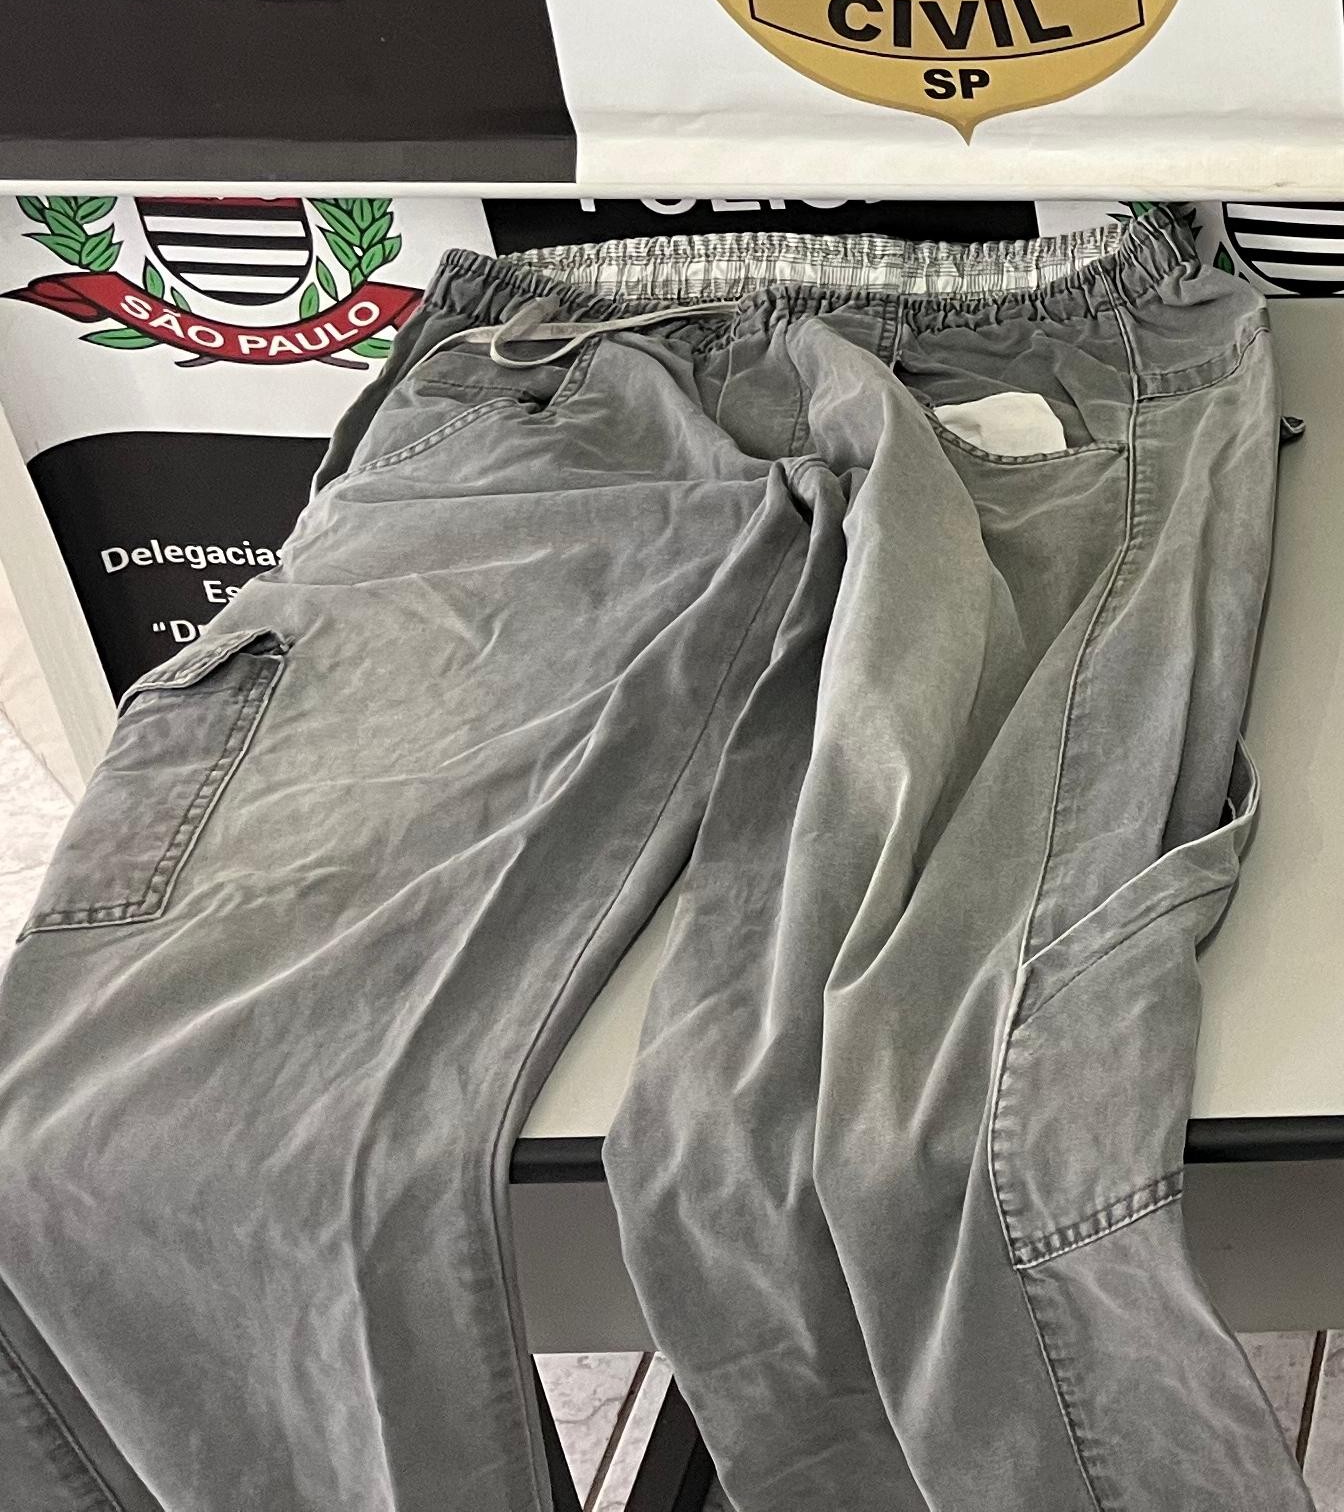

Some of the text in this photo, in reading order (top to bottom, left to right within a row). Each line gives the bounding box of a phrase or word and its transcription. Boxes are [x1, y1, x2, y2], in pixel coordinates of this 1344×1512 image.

[924, 69, 990, 99] SP
[120, 295, 380, 356] SÃO PAULO
